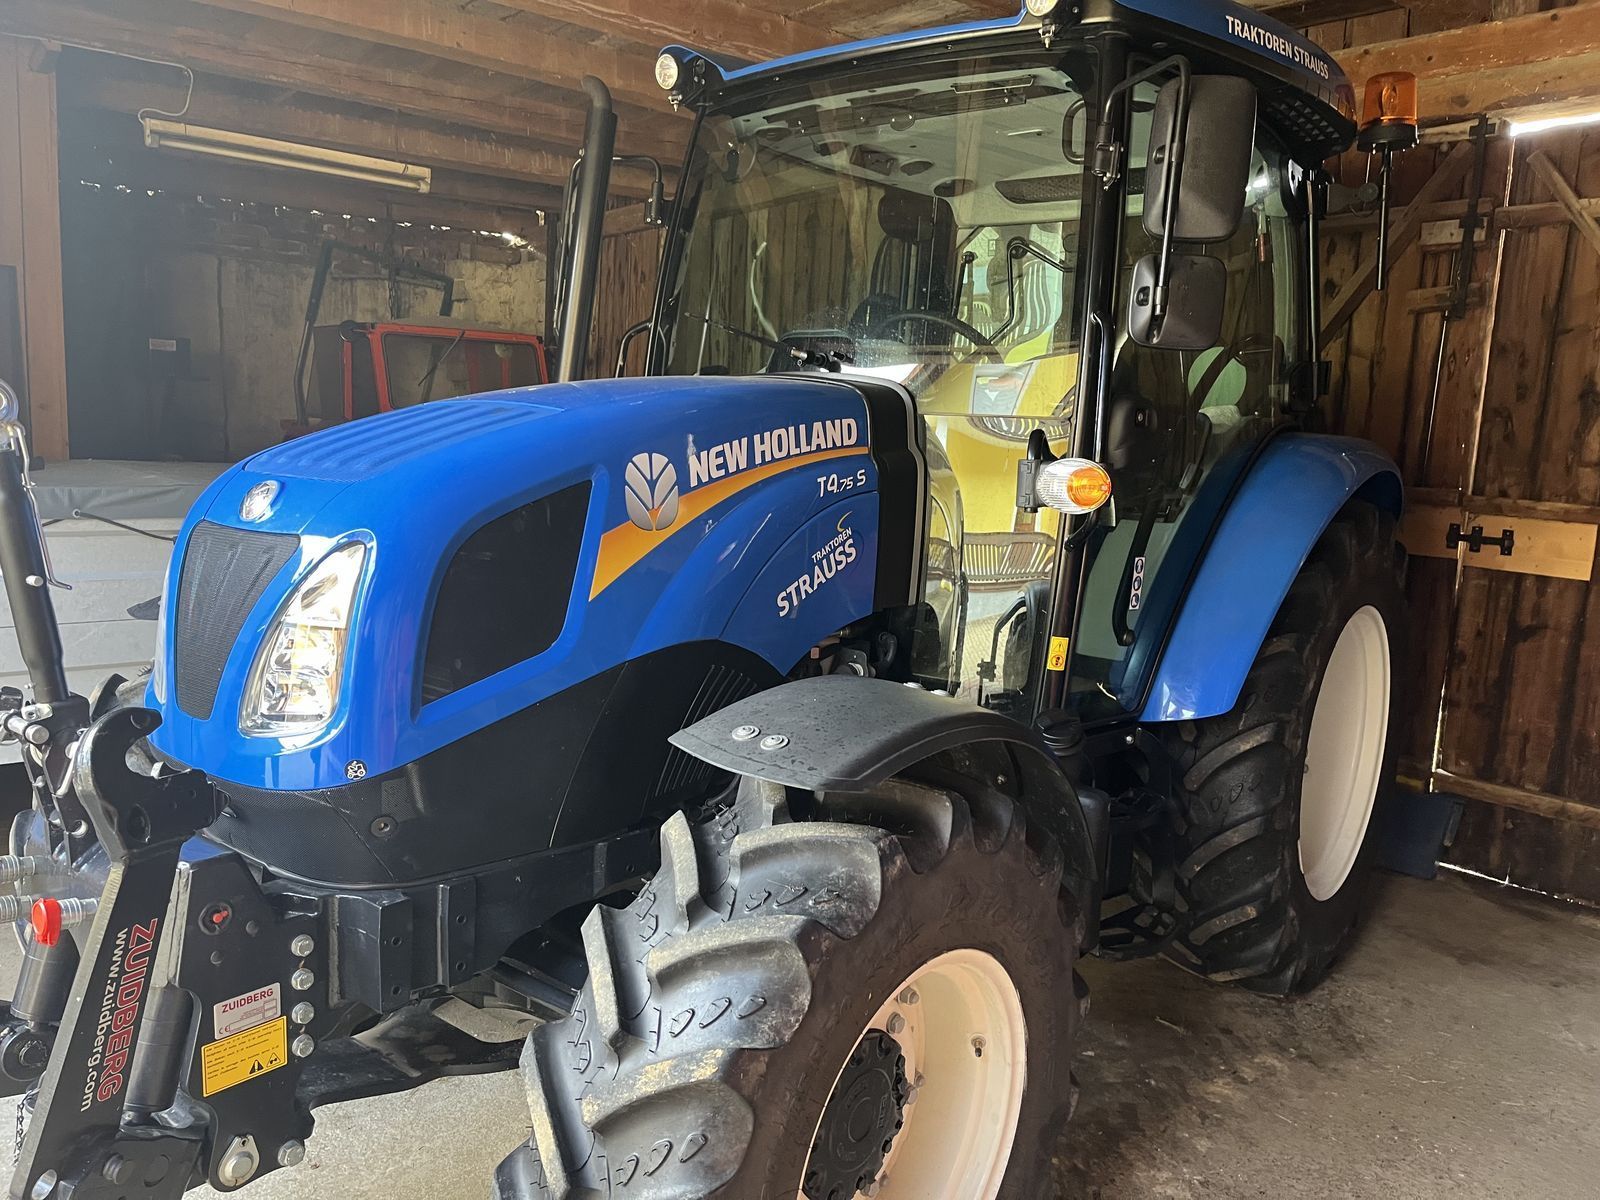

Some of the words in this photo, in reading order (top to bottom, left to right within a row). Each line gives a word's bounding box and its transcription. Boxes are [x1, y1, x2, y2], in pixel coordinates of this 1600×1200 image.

[1225, 15, 1293, 59] TRAKTOREN
[1294, 46, 1329, 80] STRAUSS
[688, 437, 748, 488] NEW
[754, 417, 858, 465] HOLLAND
[856, 469, 866, 487] S
[776, 538, 857, 618] STRAUSS
[811, 526, 852, 563] TRAKTOREN
[80, 927, 128, 1112] www.zuidberg.com
[96, 917, 159, 1102] ZUIDBERG
[221, 988, 274, 1014] ZUIDBERG
